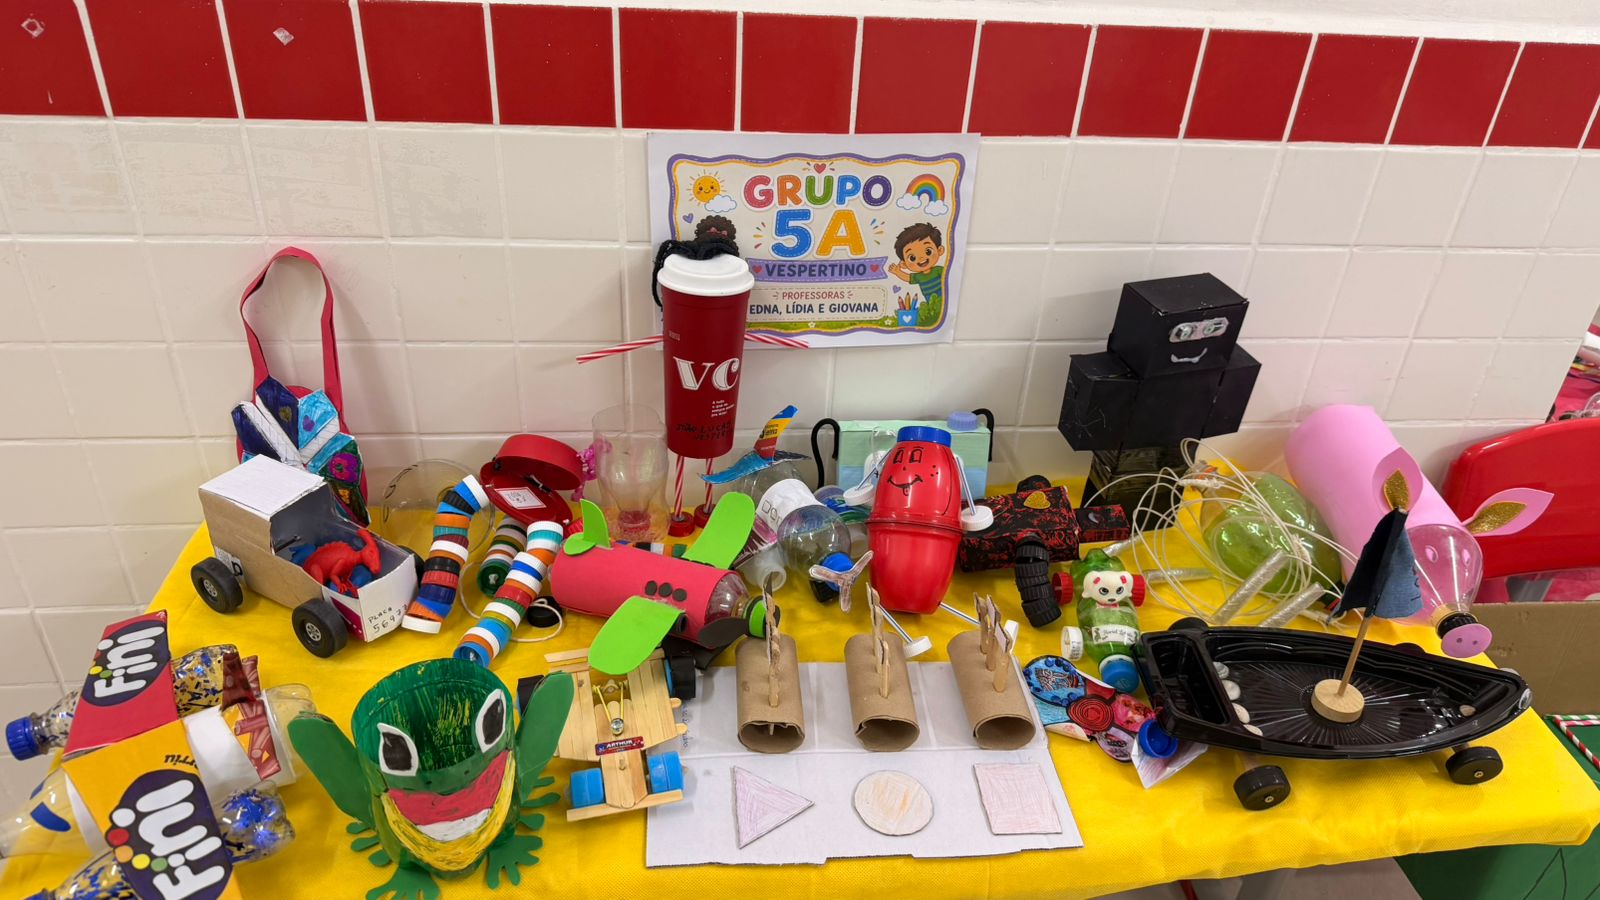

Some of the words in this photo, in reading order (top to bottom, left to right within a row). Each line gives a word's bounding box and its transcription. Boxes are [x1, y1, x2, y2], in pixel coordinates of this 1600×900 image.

[743, 174, 893, 209] GRUPO
[771, 208, 866, 258] 5A
[764, 263, 867, 278] VESPERTINO
[750, 304, 782, 316] EDNA,
[786, 300, 814, 314] LÍDIA
[818, 303, 825, 313] E
[829, 302, 879, 314] GIOVANA
[782, 290, 845, 301] PROFESSORAS
[673, 356, 740, 391] VC
[93, 626, 165, 698] Fini
[606, 739, 634, 749] ARTHUR
[112, 779, 225, 900] Fini
